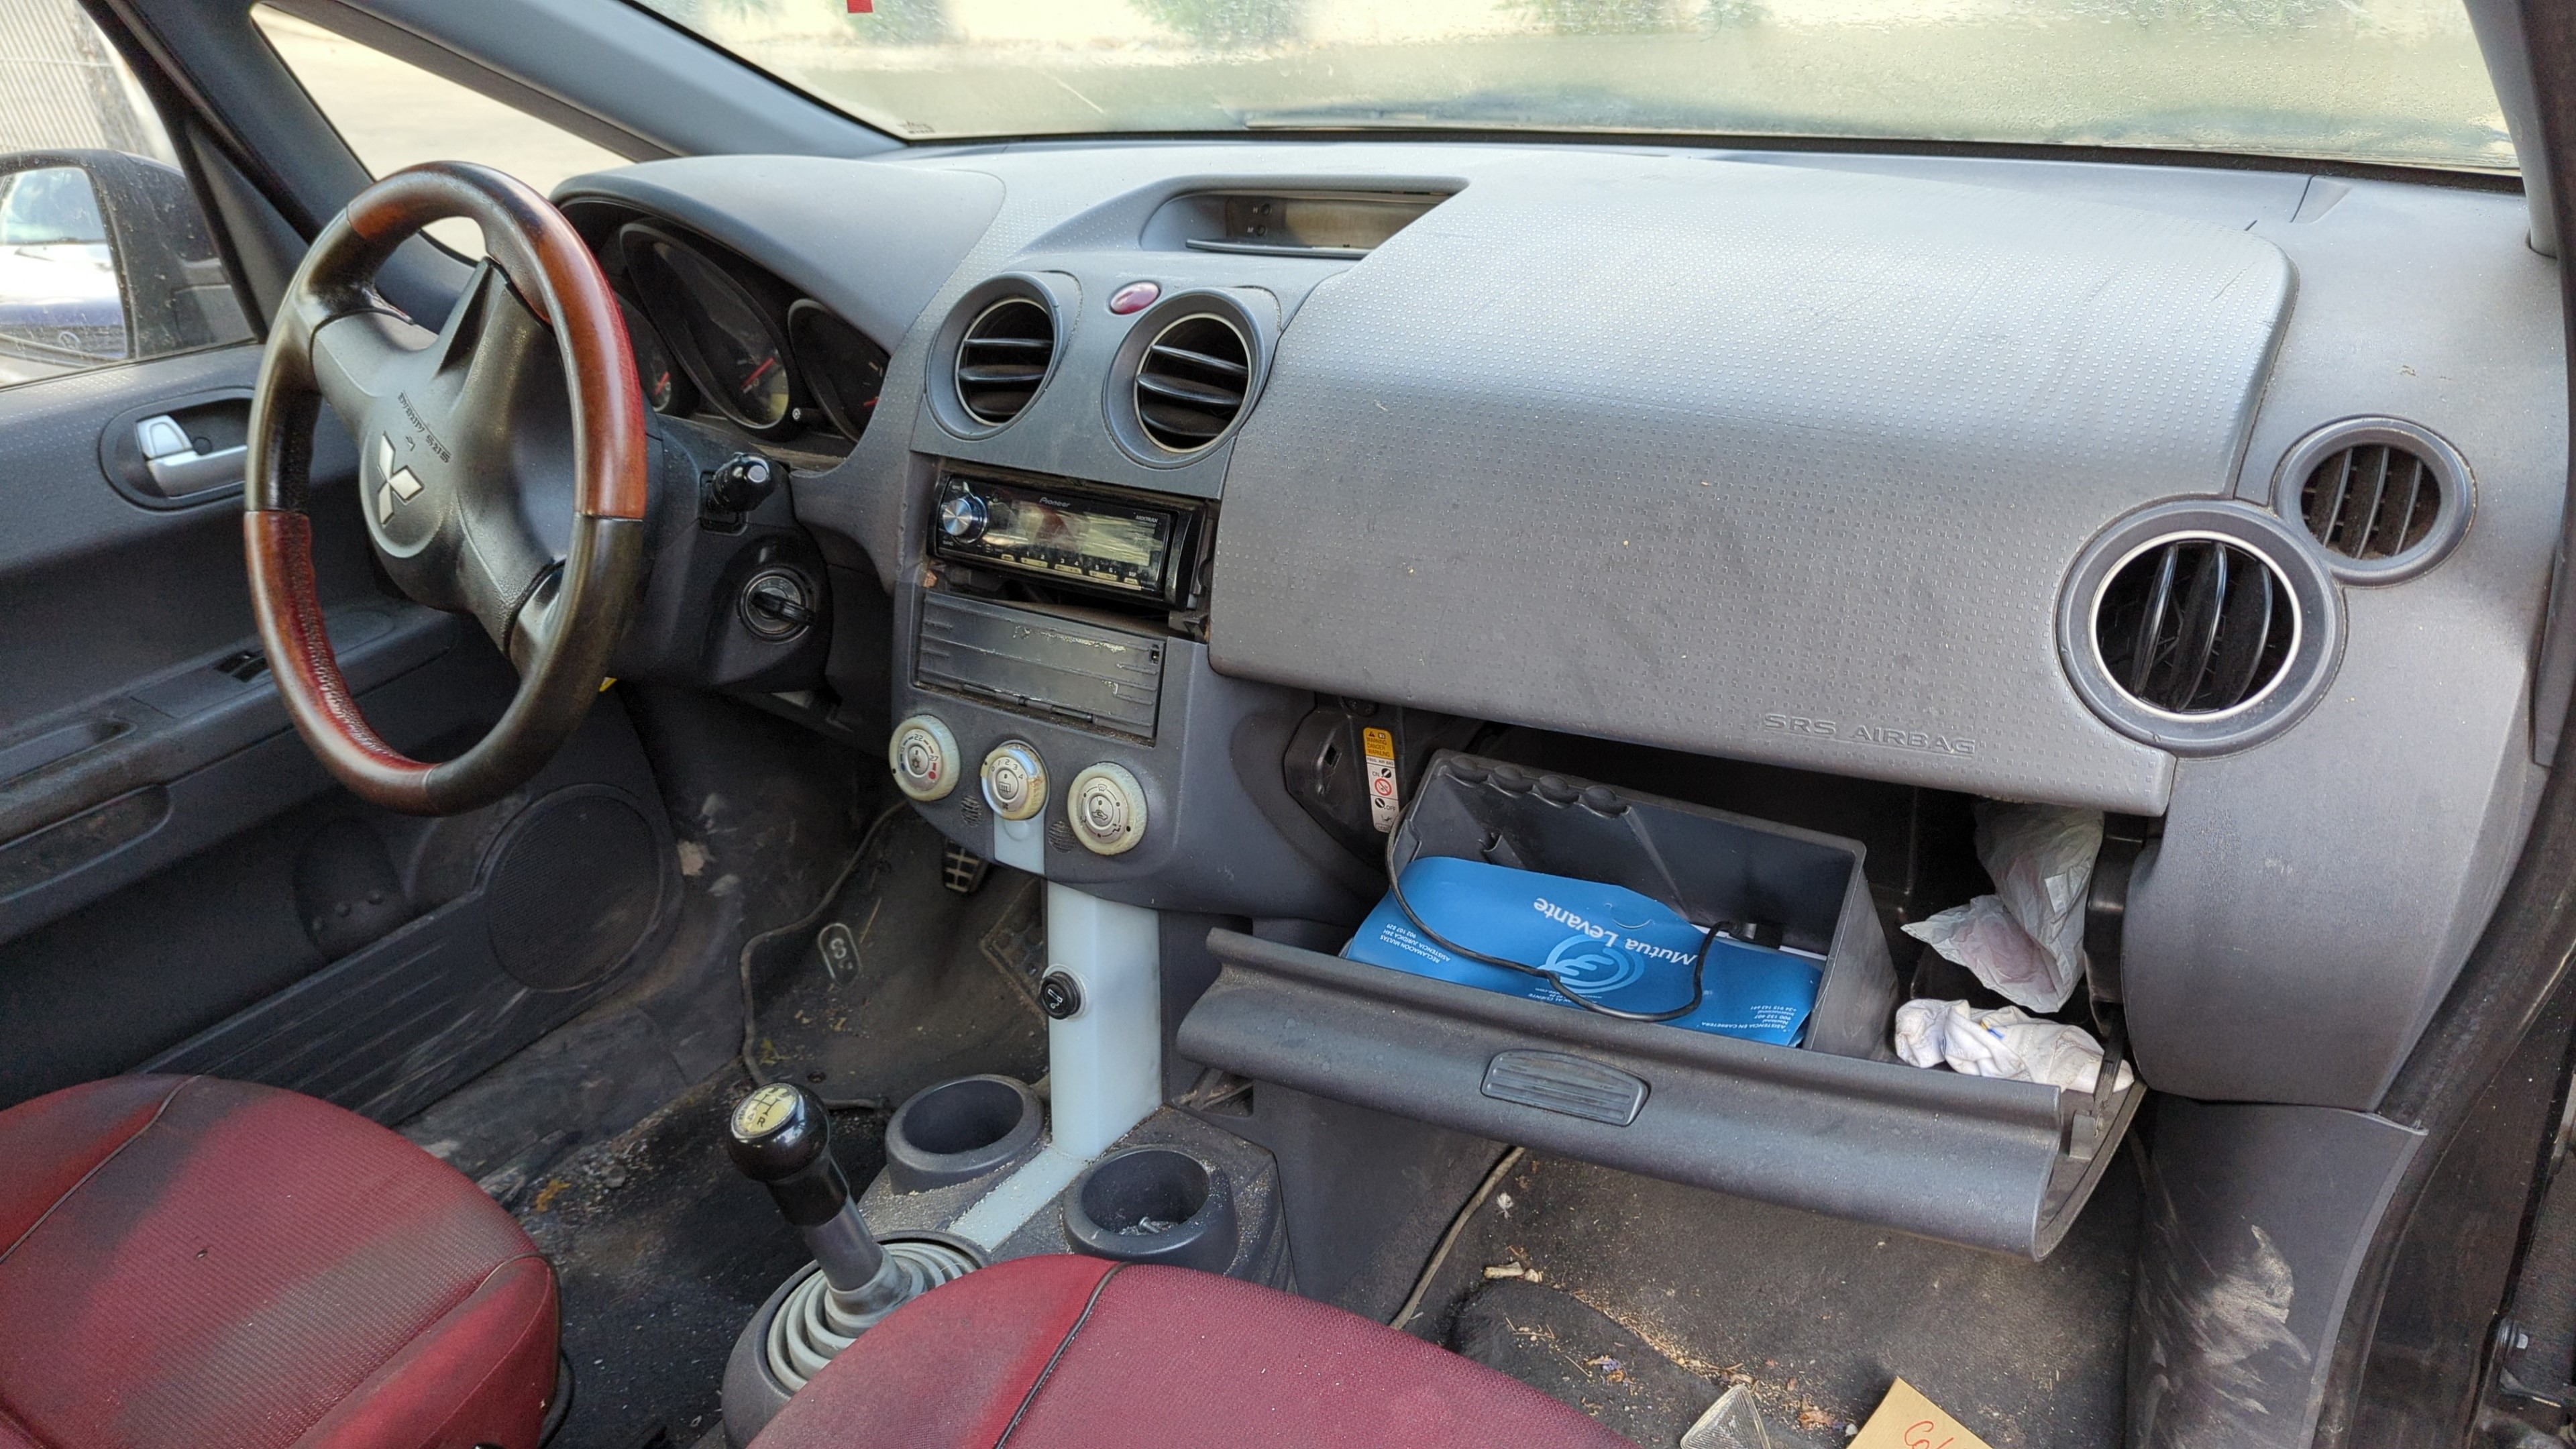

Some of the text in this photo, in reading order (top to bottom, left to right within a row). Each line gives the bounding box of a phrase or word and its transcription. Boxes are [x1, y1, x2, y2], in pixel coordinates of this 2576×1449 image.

[425, 434, 451, 463] SRS
[1040, 496, 1071, 508] Pioneer
[914, 733, 923, 742] 22
[1764, 713, 1976, 754] SRS AIRBAG
[1534, 898, 1698, 965] Mutua Levante
[1380, 934, 1400, 947] MULTAS
[1419, 943, 1450, 961] ASISTENCIA
[757, 1116, 765, 1128] R
